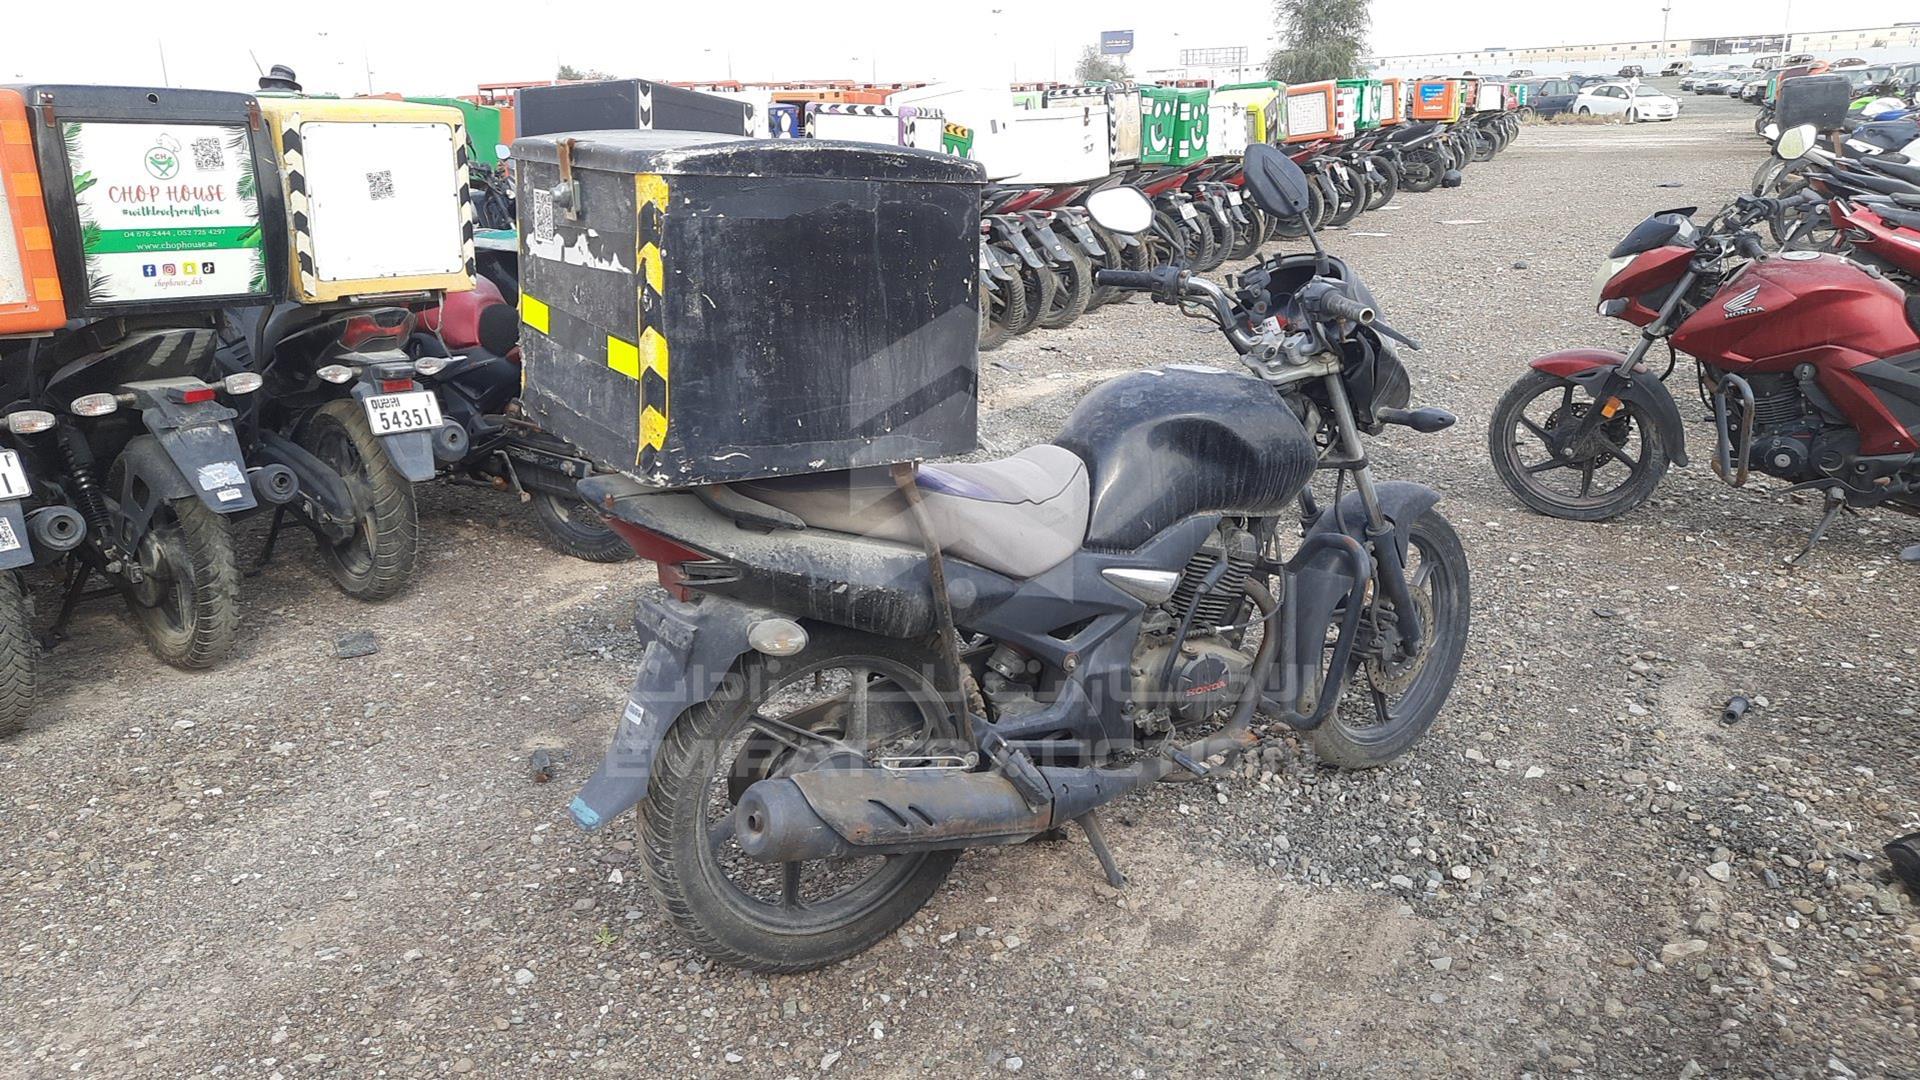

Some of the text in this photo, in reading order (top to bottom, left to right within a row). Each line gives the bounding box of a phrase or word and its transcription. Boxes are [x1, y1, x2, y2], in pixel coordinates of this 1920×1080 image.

[108, 184, 226, 203] CHOP HOUSE
[136, 241, 217, 250] www.chophouse.ae
[1724, 306, 1765, 320] HONDA
[380, 408, 431, 430] 54351
[1186, 679, 1227, 697] HONDA
